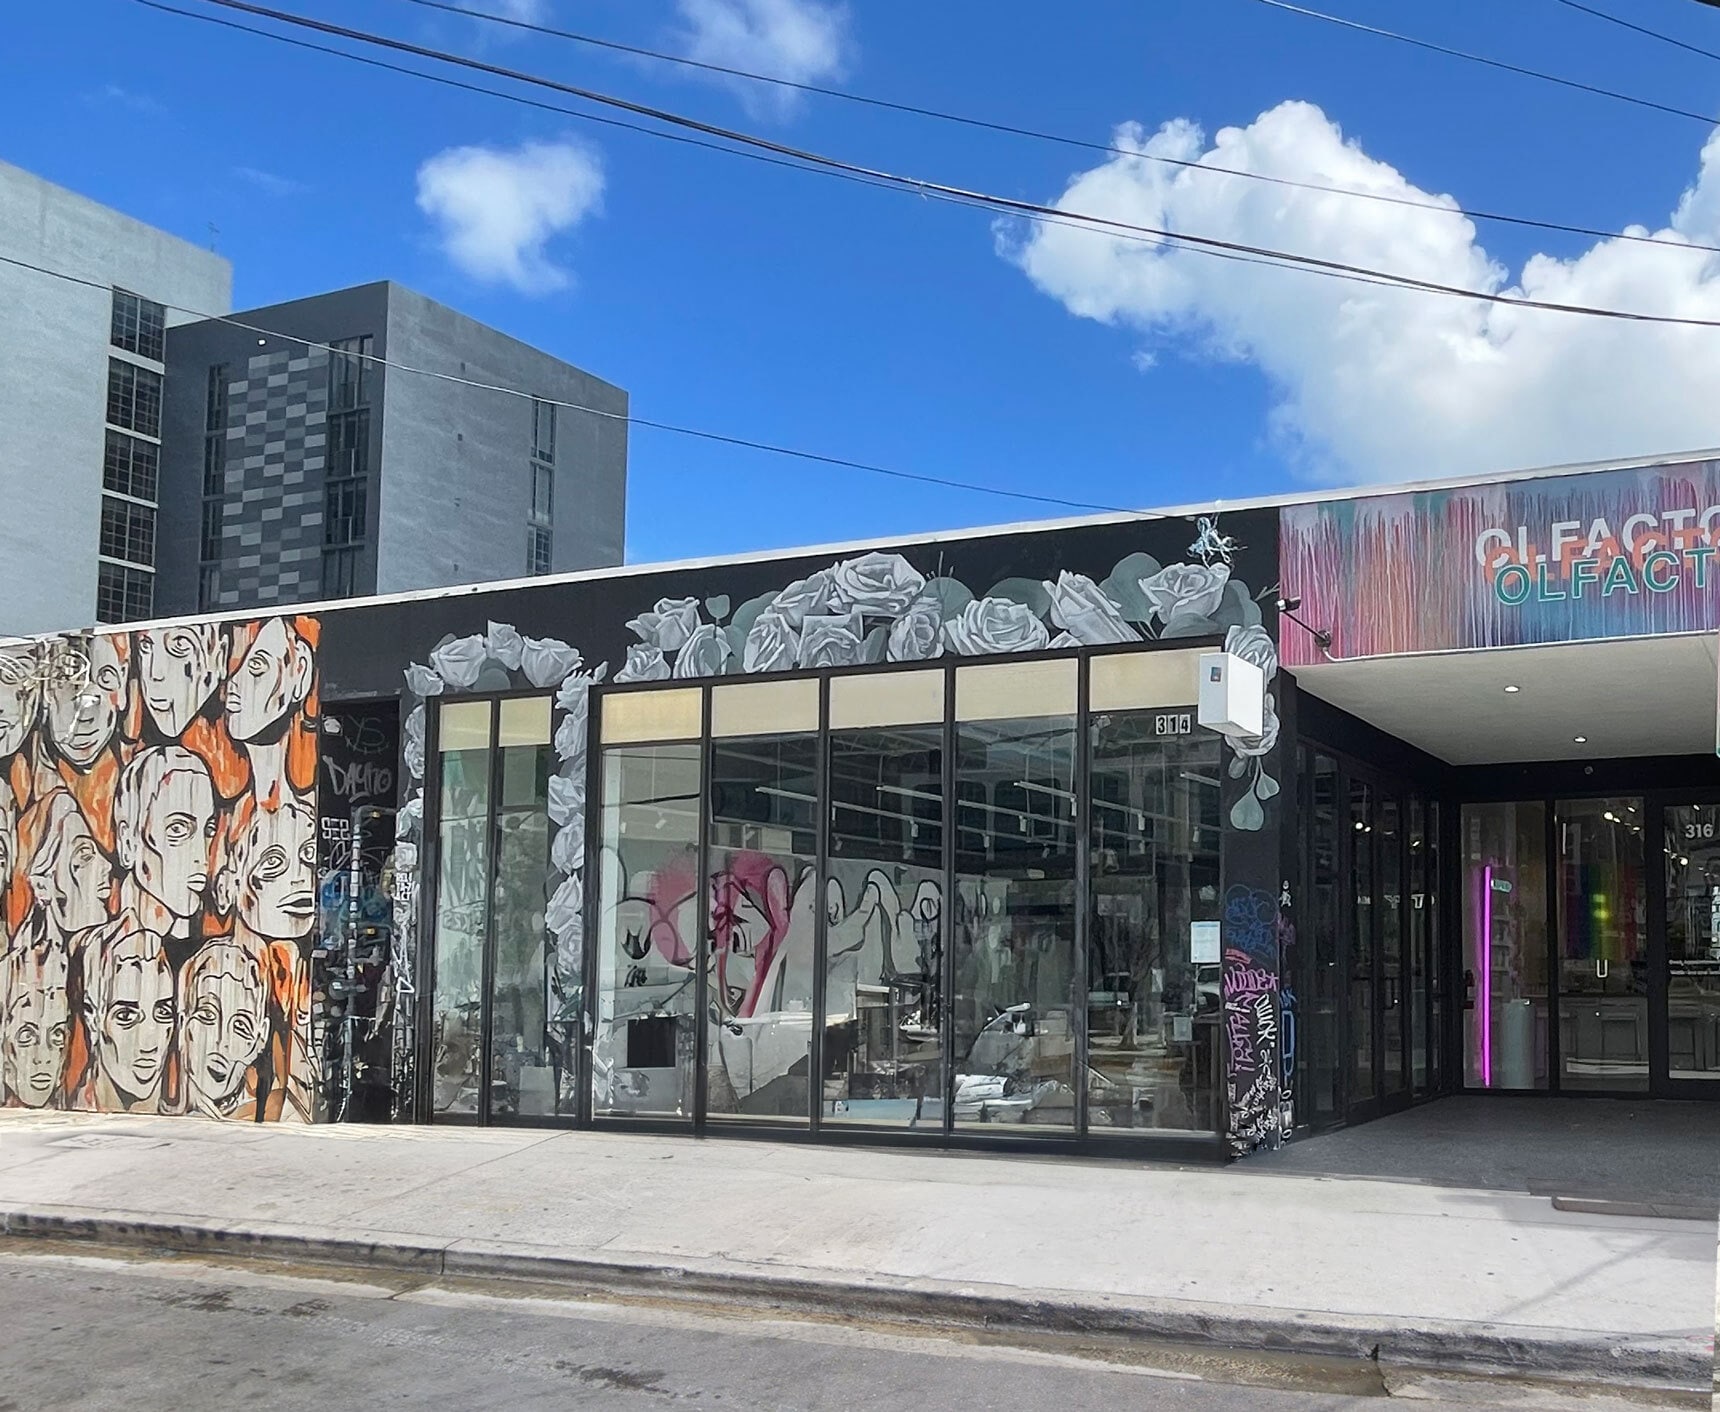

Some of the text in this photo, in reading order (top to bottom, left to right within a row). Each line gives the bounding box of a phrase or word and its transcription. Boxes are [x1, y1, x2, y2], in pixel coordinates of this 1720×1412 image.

[1495, 547, 1716, 605] OLFACT
[1156, 714, 1190, 734] 314
[1685, 823, 1713, 838] 316
